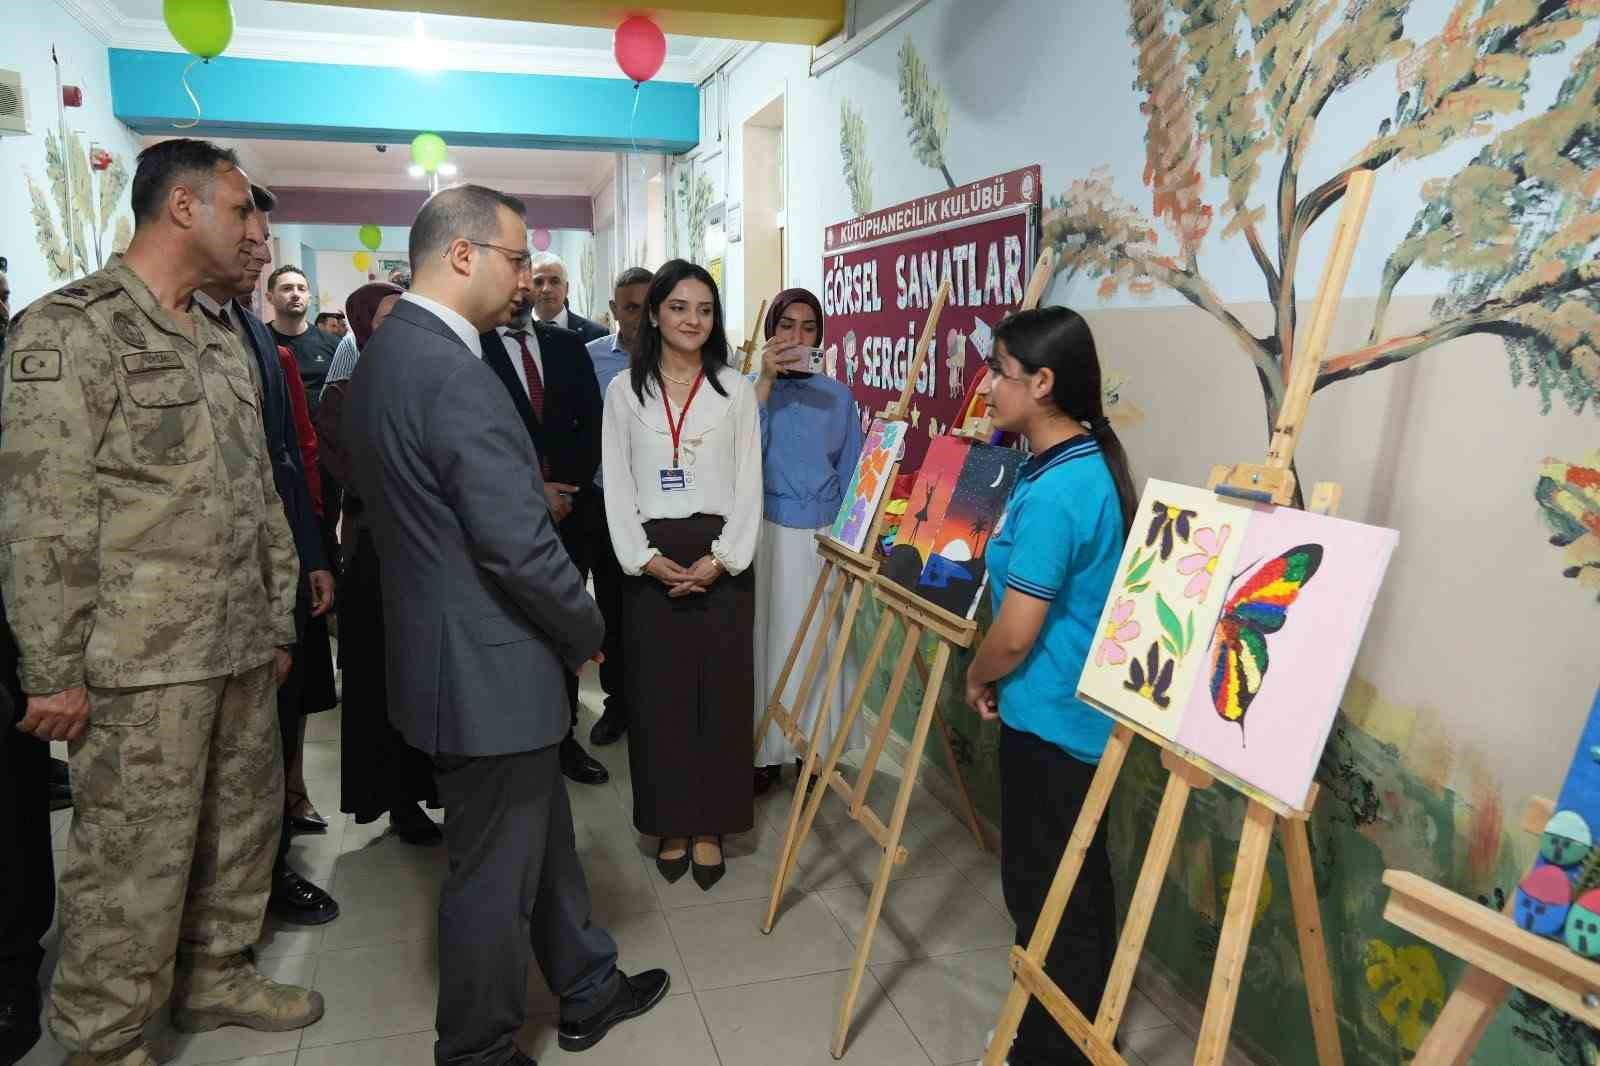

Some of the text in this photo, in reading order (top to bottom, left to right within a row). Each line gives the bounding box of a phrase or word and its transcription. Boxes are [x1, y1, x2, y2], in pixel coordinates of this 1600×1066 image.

[841, 179, 1006, 243] KÜTÜPHANECİLİK KULÜBÜ
[825, 235, 1024, 316] GÖRSEL SANATLAR
